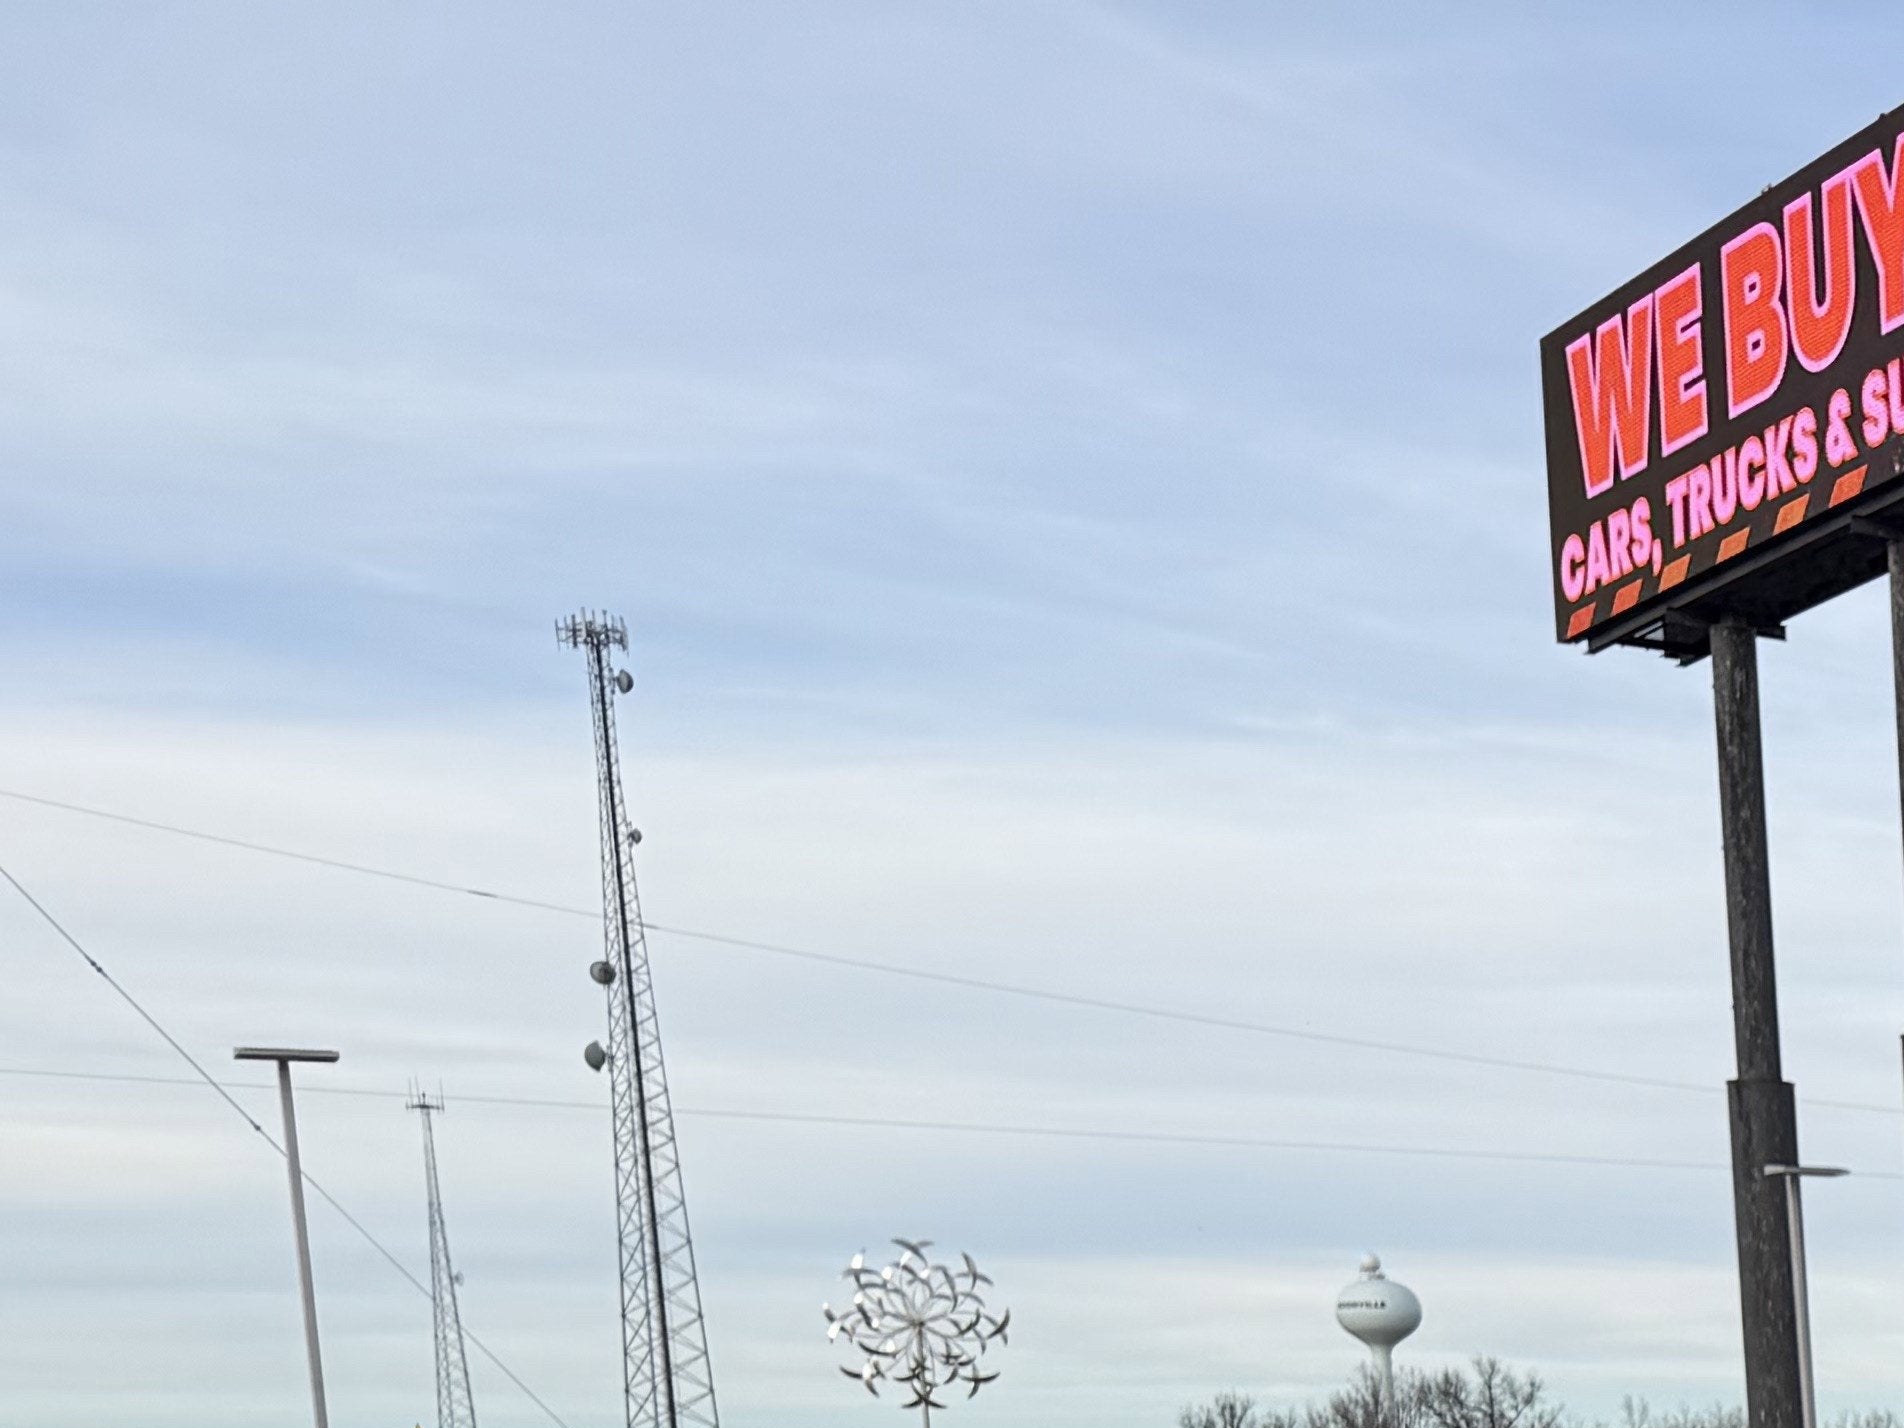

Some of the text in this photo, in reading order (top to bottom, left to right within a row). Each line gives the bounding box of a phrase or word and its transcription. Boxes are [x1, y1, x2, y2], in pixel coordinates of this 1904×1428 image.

[1565, 262, 1708, 499] WE
[1561, 496, 1662, 602] CARS,
[1665, 406, 1818, 549] TRUCKS
[1825, 388, 1859, 468] &
